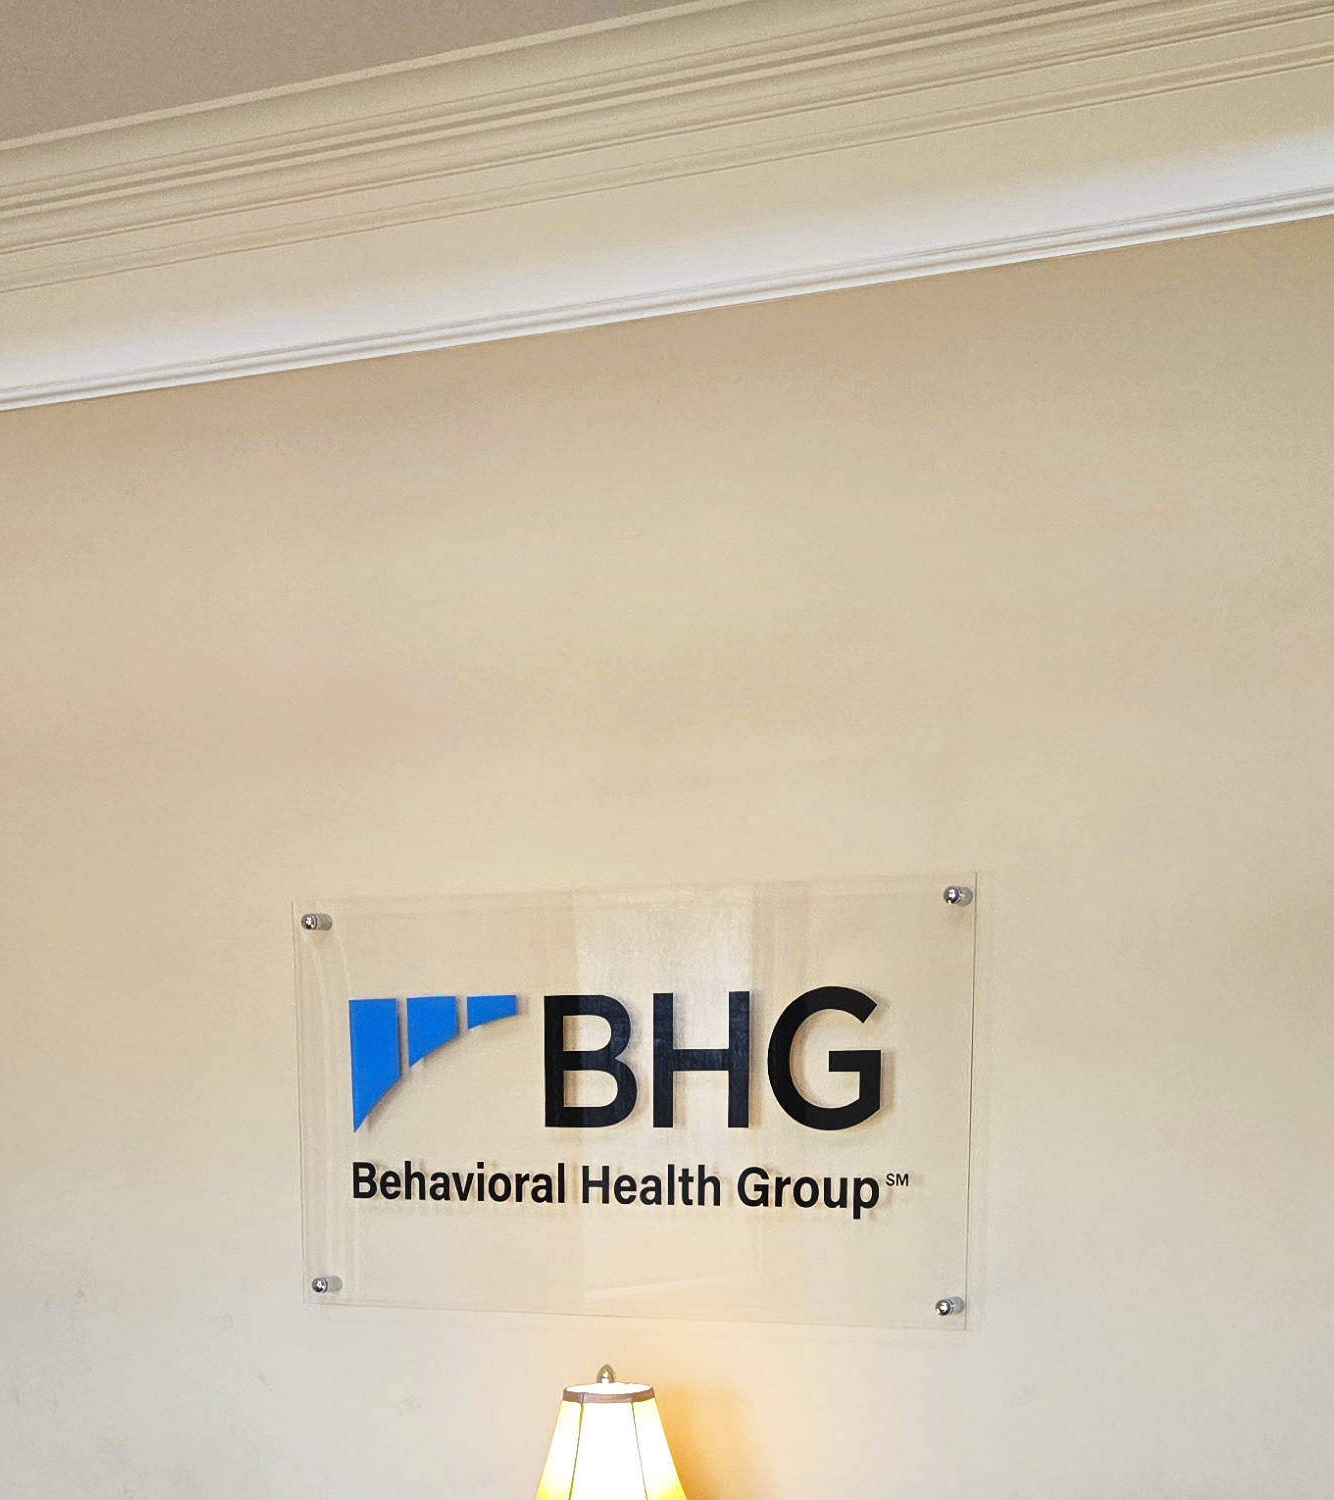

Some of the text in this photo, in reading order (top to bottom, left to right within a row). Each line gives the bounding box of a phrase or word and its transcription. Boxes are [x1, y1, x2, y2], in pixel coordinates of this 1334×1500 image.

[543, 985, 882, 1131] BHG
[352, 1160, 566, 1204] Behavioral
[581, 1163, 721, 1207] Health
[736, 1166, 881, 1220] Group
